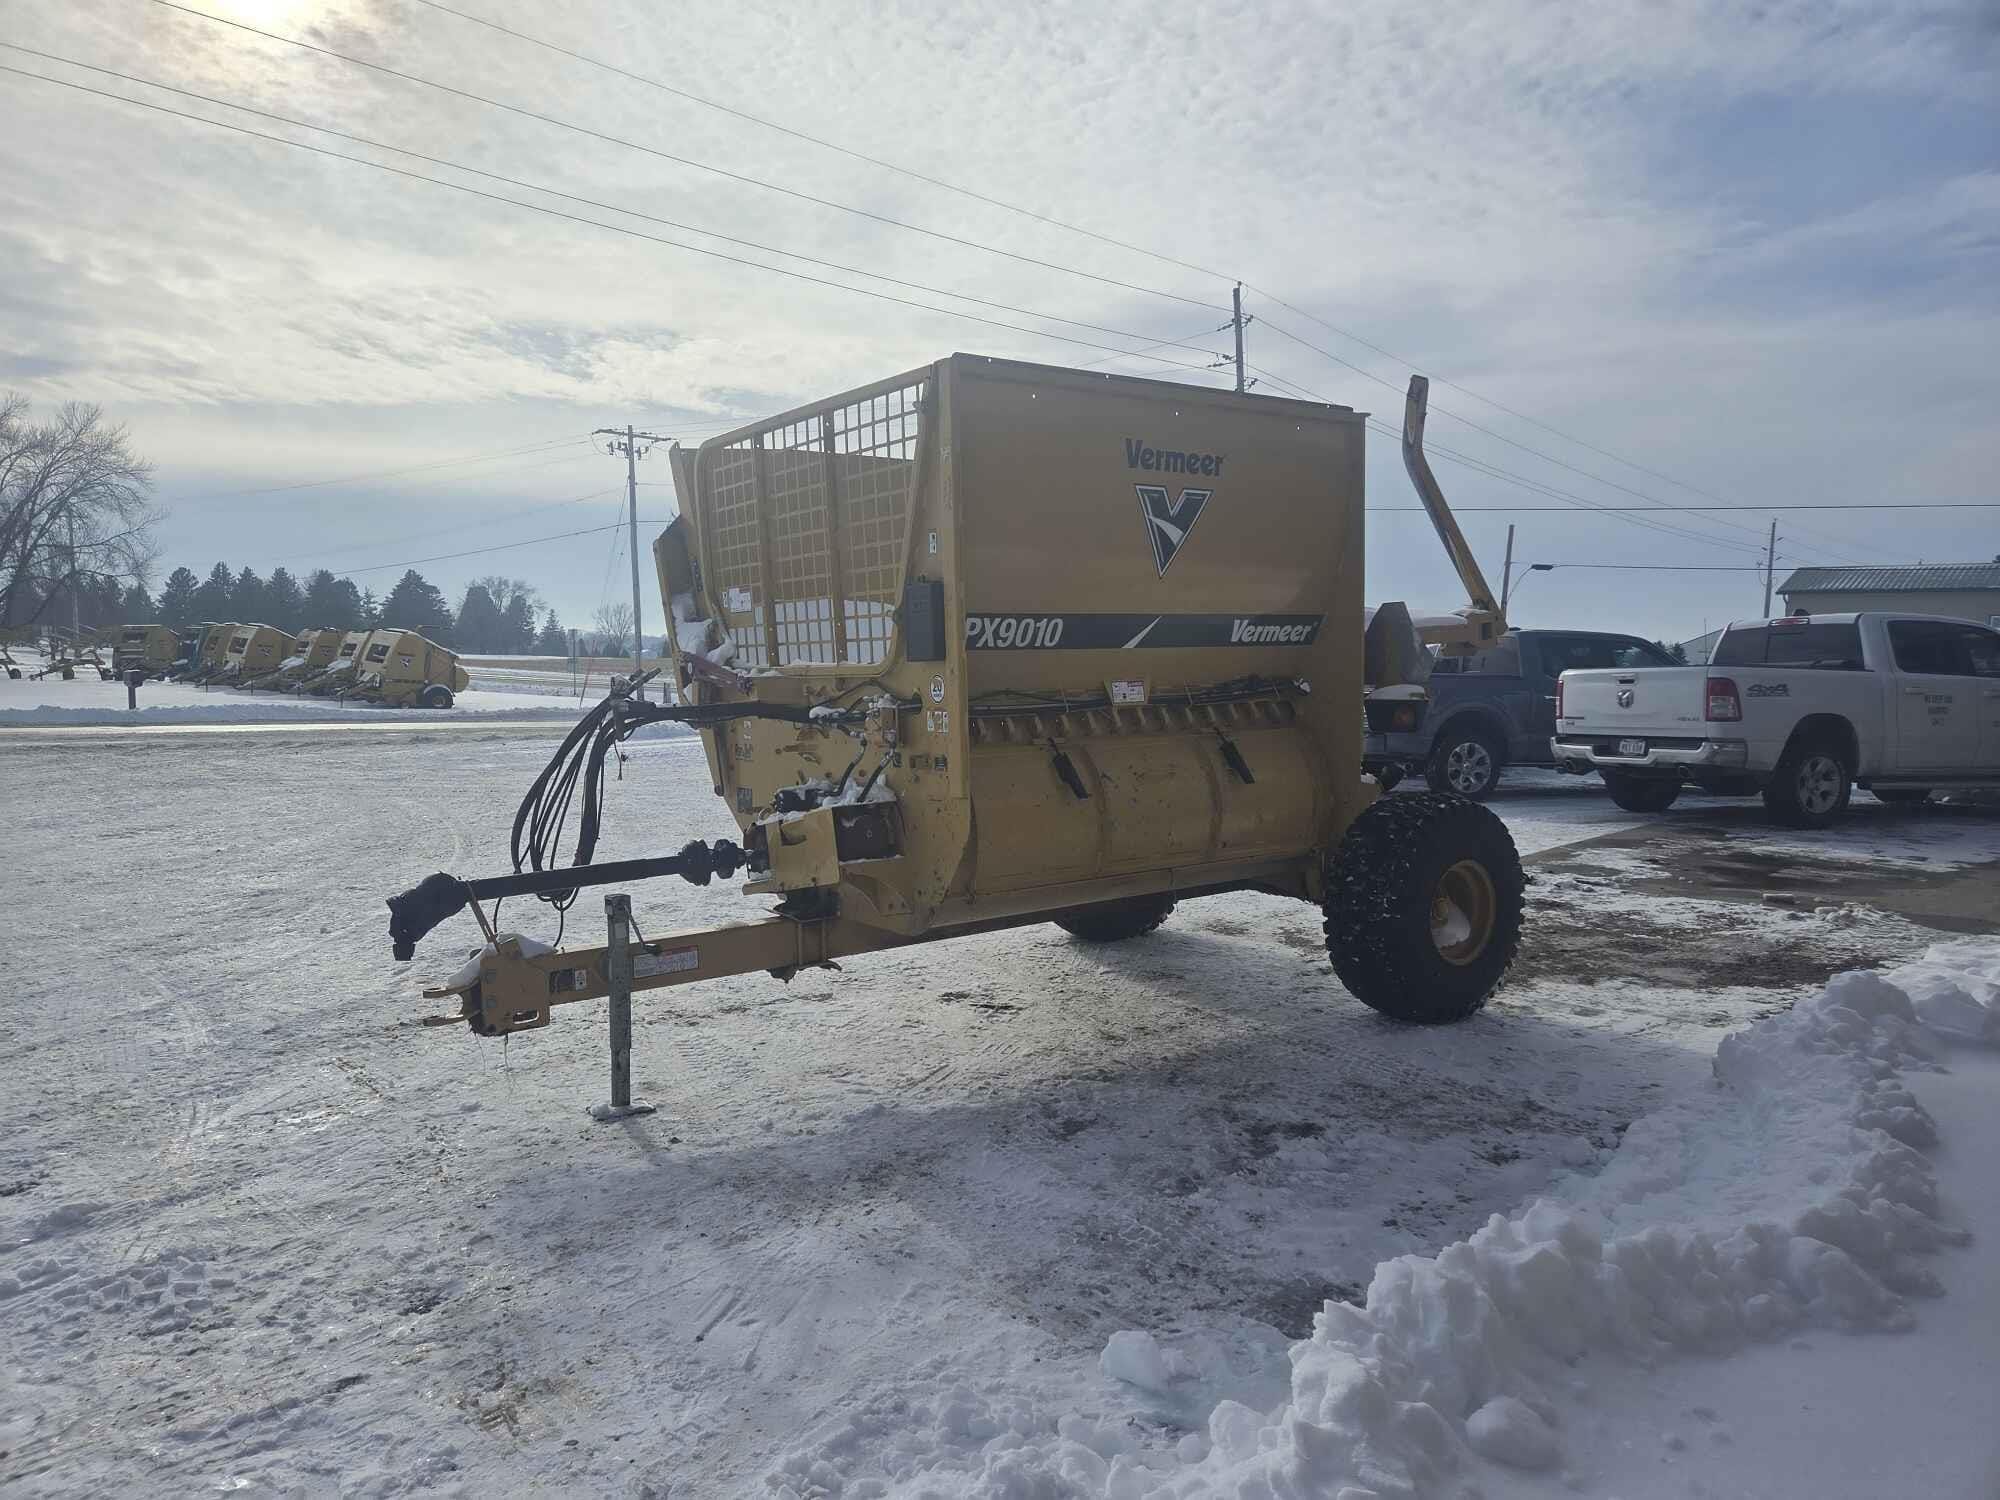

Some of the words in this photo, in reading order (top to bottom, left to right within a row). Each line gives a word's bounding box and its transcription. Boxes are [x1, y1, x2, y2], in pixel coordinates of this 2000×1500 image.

[1125, 438, 1224, 477] Vermeer
[964, 617, 1063, 648] PX9010
[1231, 619, 1312, 642] Vermeer
